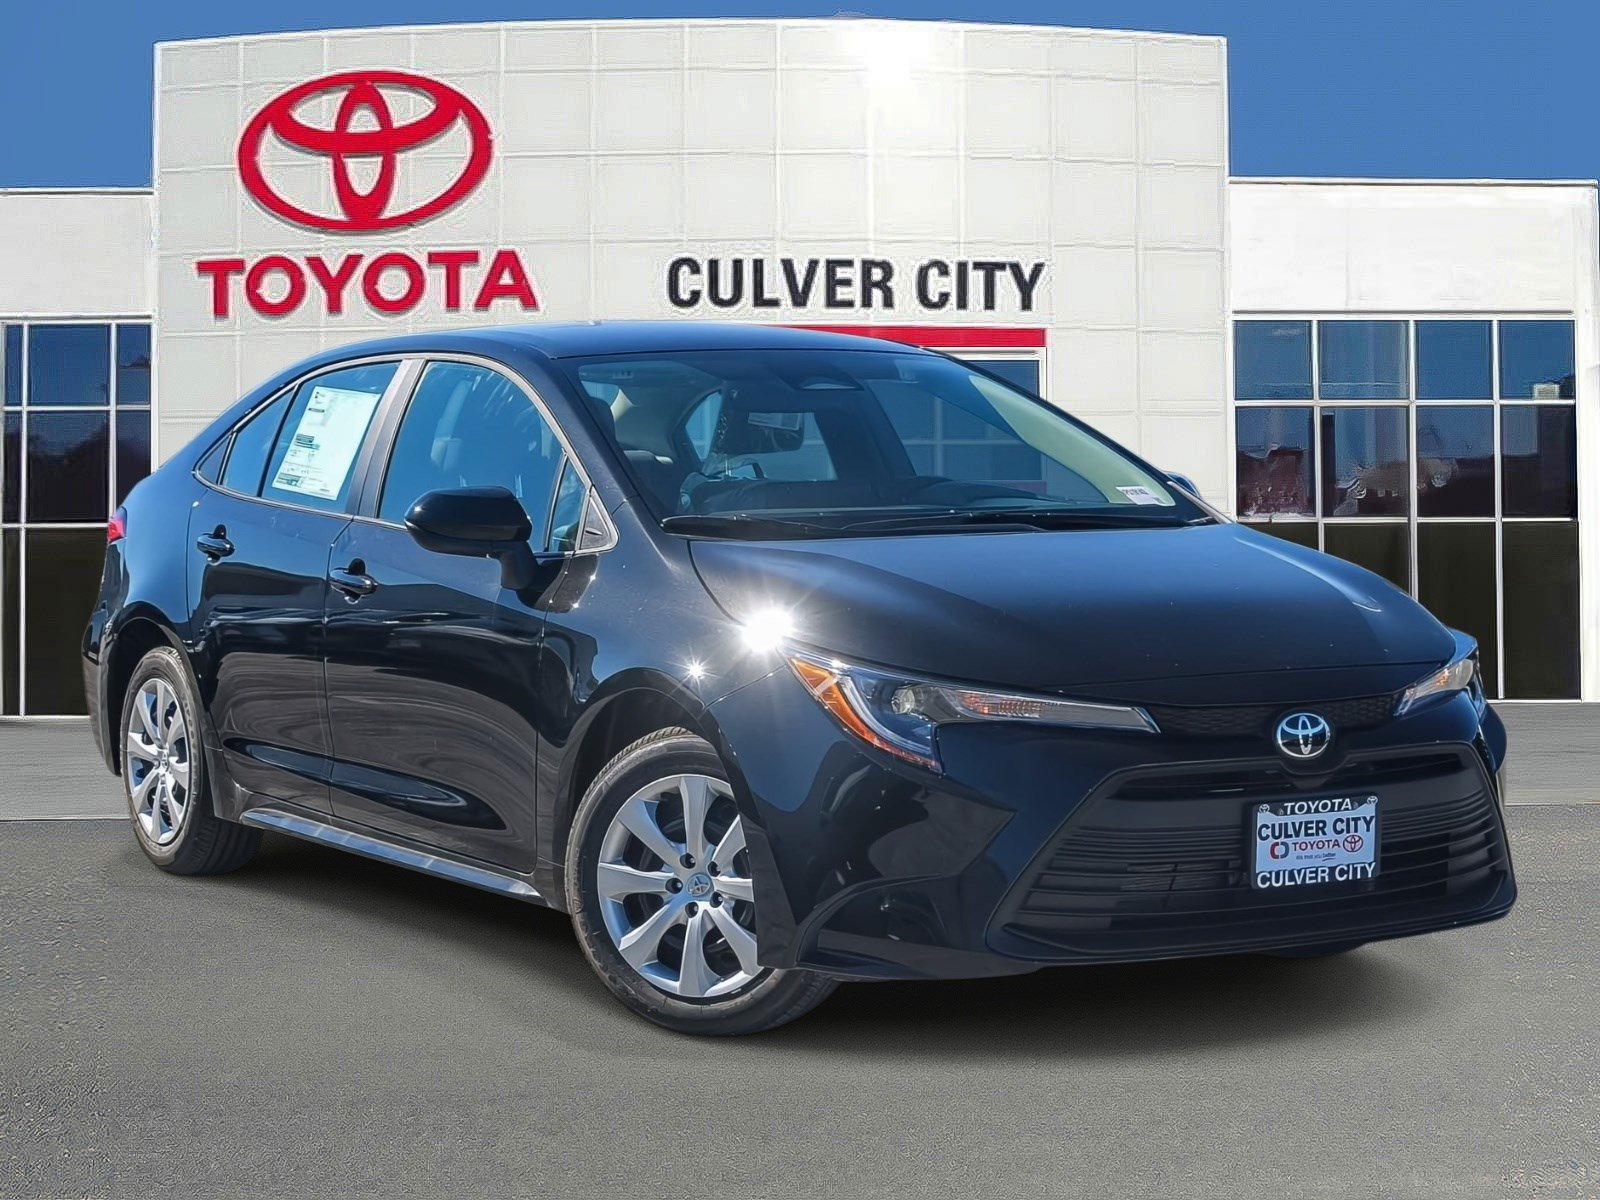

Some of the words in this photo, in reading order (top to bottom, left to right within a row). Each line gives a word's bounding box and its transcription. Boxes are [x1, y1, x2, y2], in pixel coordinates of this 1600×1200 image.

[196, 249, 539, 319] TOYOTA
[668, 256, 895, 310] CULVER
[916, 256, 1045, 311] CITY
[1284, 798, 1352, 815] TOYOTA
[1257, 819, 1327, 841] CULVER
[1333, 815, 1375, 835] CITY
[1292, 839, 1341, 852] TOYOTA
[1257, 867, 1330, 888] CULVER
[1335, 862, 1376, 881] CITY
